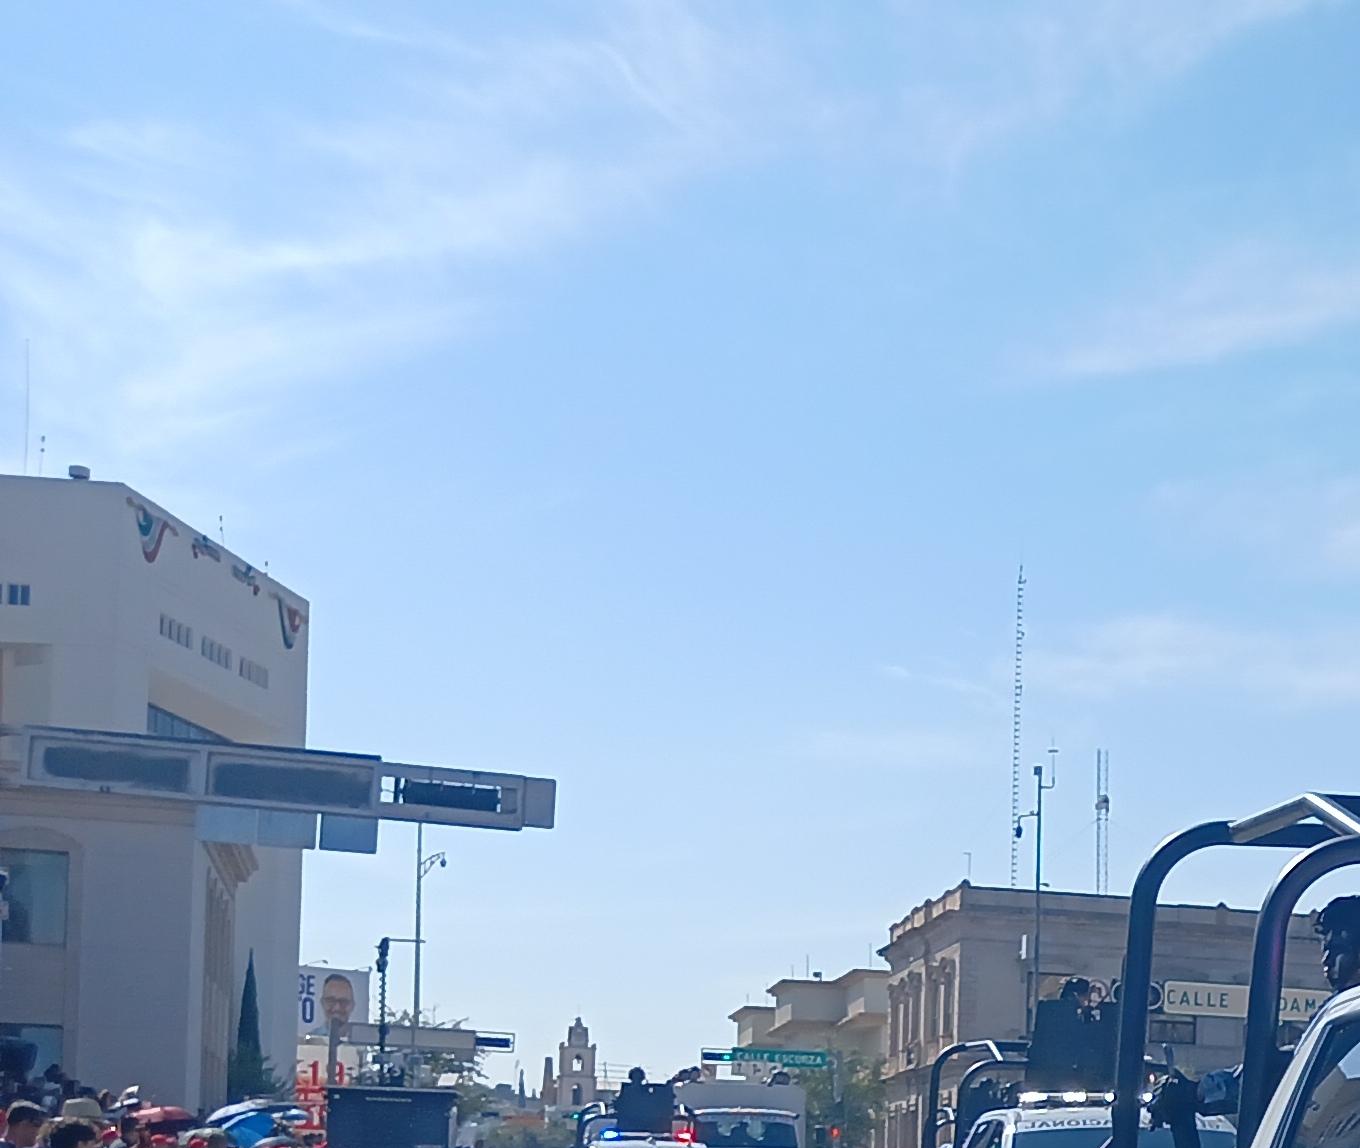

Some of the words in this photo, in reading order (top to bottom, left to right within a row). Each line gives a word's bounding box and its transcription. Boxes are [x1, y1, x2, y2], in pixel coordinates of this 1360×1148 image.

[1166, 989, 1230, 1009] CALLE
[1280, 997, 1317, 1013] DAM
[737, 1052, 770, 1061] CALLE
